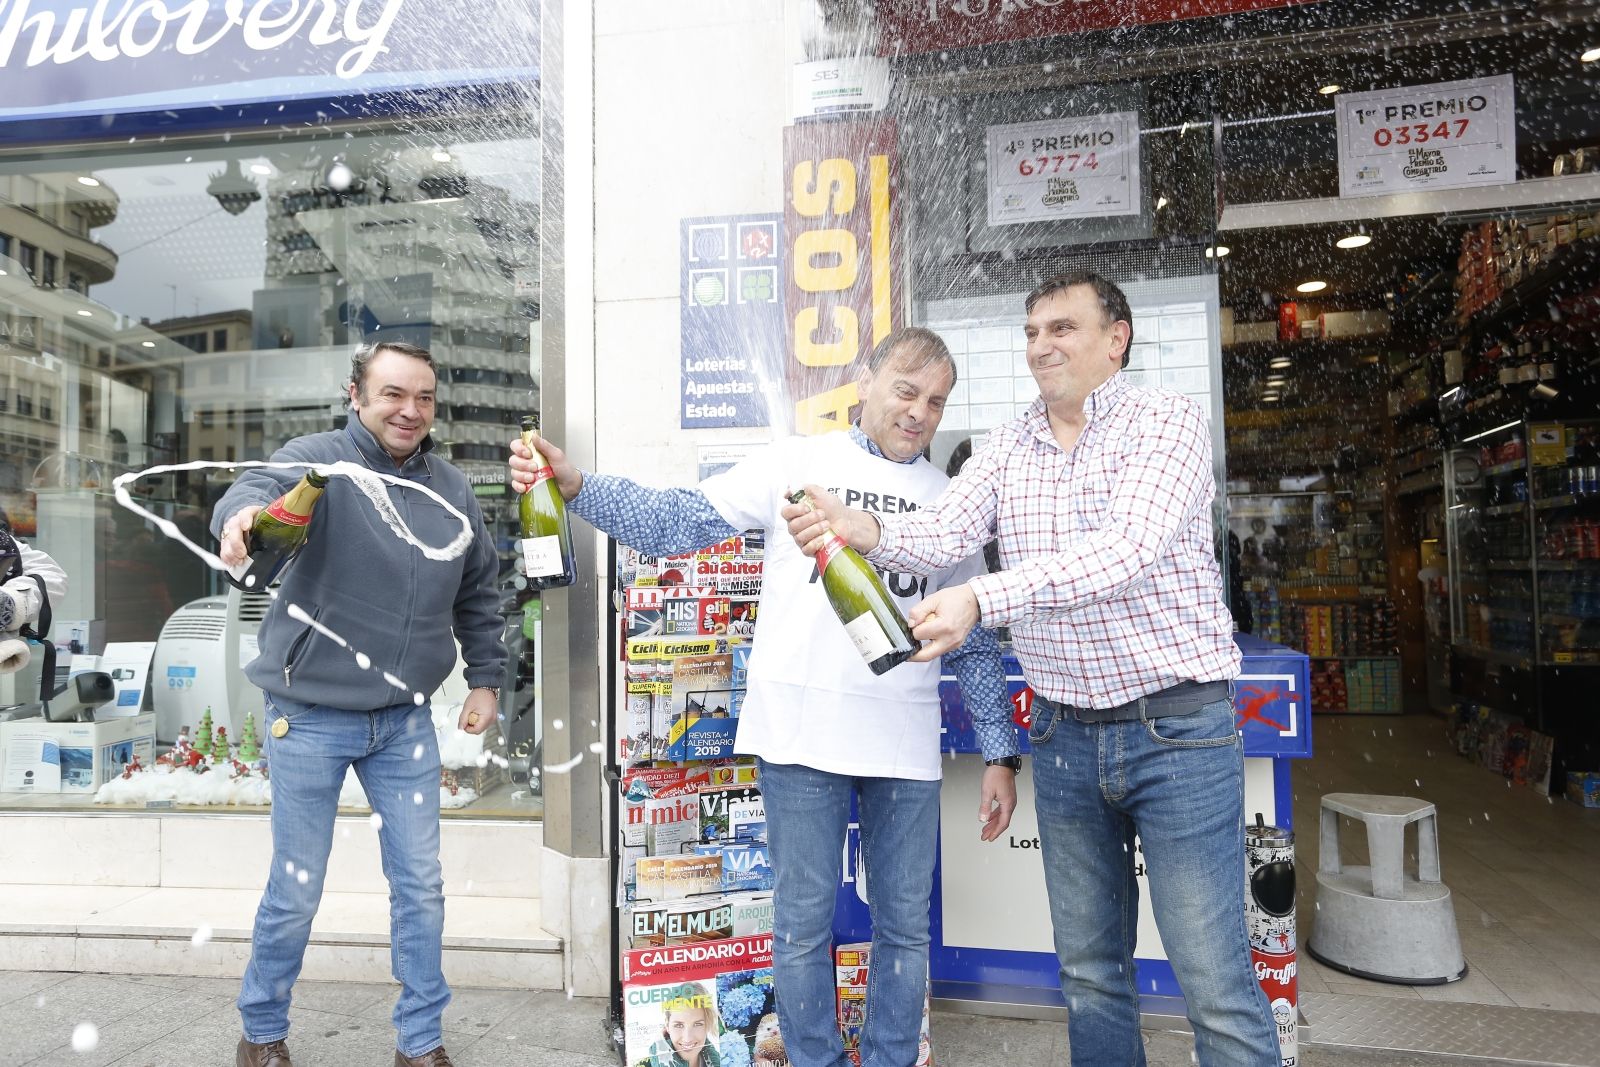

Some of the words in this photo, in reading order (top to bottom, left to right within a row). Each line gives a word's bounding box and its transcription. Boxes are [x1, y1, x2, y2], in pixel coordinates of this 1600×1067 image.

[1355, 108, 1376, 125] 1er
[1385, 95, 1487, 122] PREMIO
[1373, 118, 1470, 147] 03347
[1032, 131, 1114, 152] PREMIO
[1019, 152, 1099, 176] 67774
[1409, 155, 1434, 168] PREMIO
[685, 356, 746, 373] Loterías
[685, 380, 755, 398] Apuestas
[685, 403, 737, 419] Estado
[464, 472, 506, 484] timate
[845, 489, 922, 513] PREM
[632, 644, 659, 654] Cicli
[664, 643, 711, 655] Ciclismo
[678, 667, 719, 678] CASTILLA
[688, 731, 722, 739] REVISTA
[694, 746, 721, 756] 2019
[652, 800, 699, 826] mic
[1010, 836, 1040, 850] Lot
[728, 850, 771, 870] VIA
[667, 914, 687, 937] EL
[640, 943, 745, 967] CALENDARIO
[628, 985, 696, 1006] CUERPO
[662, 993, 713, 1010] MENTE
[1281, 1057, 1295, 1067] BOY
